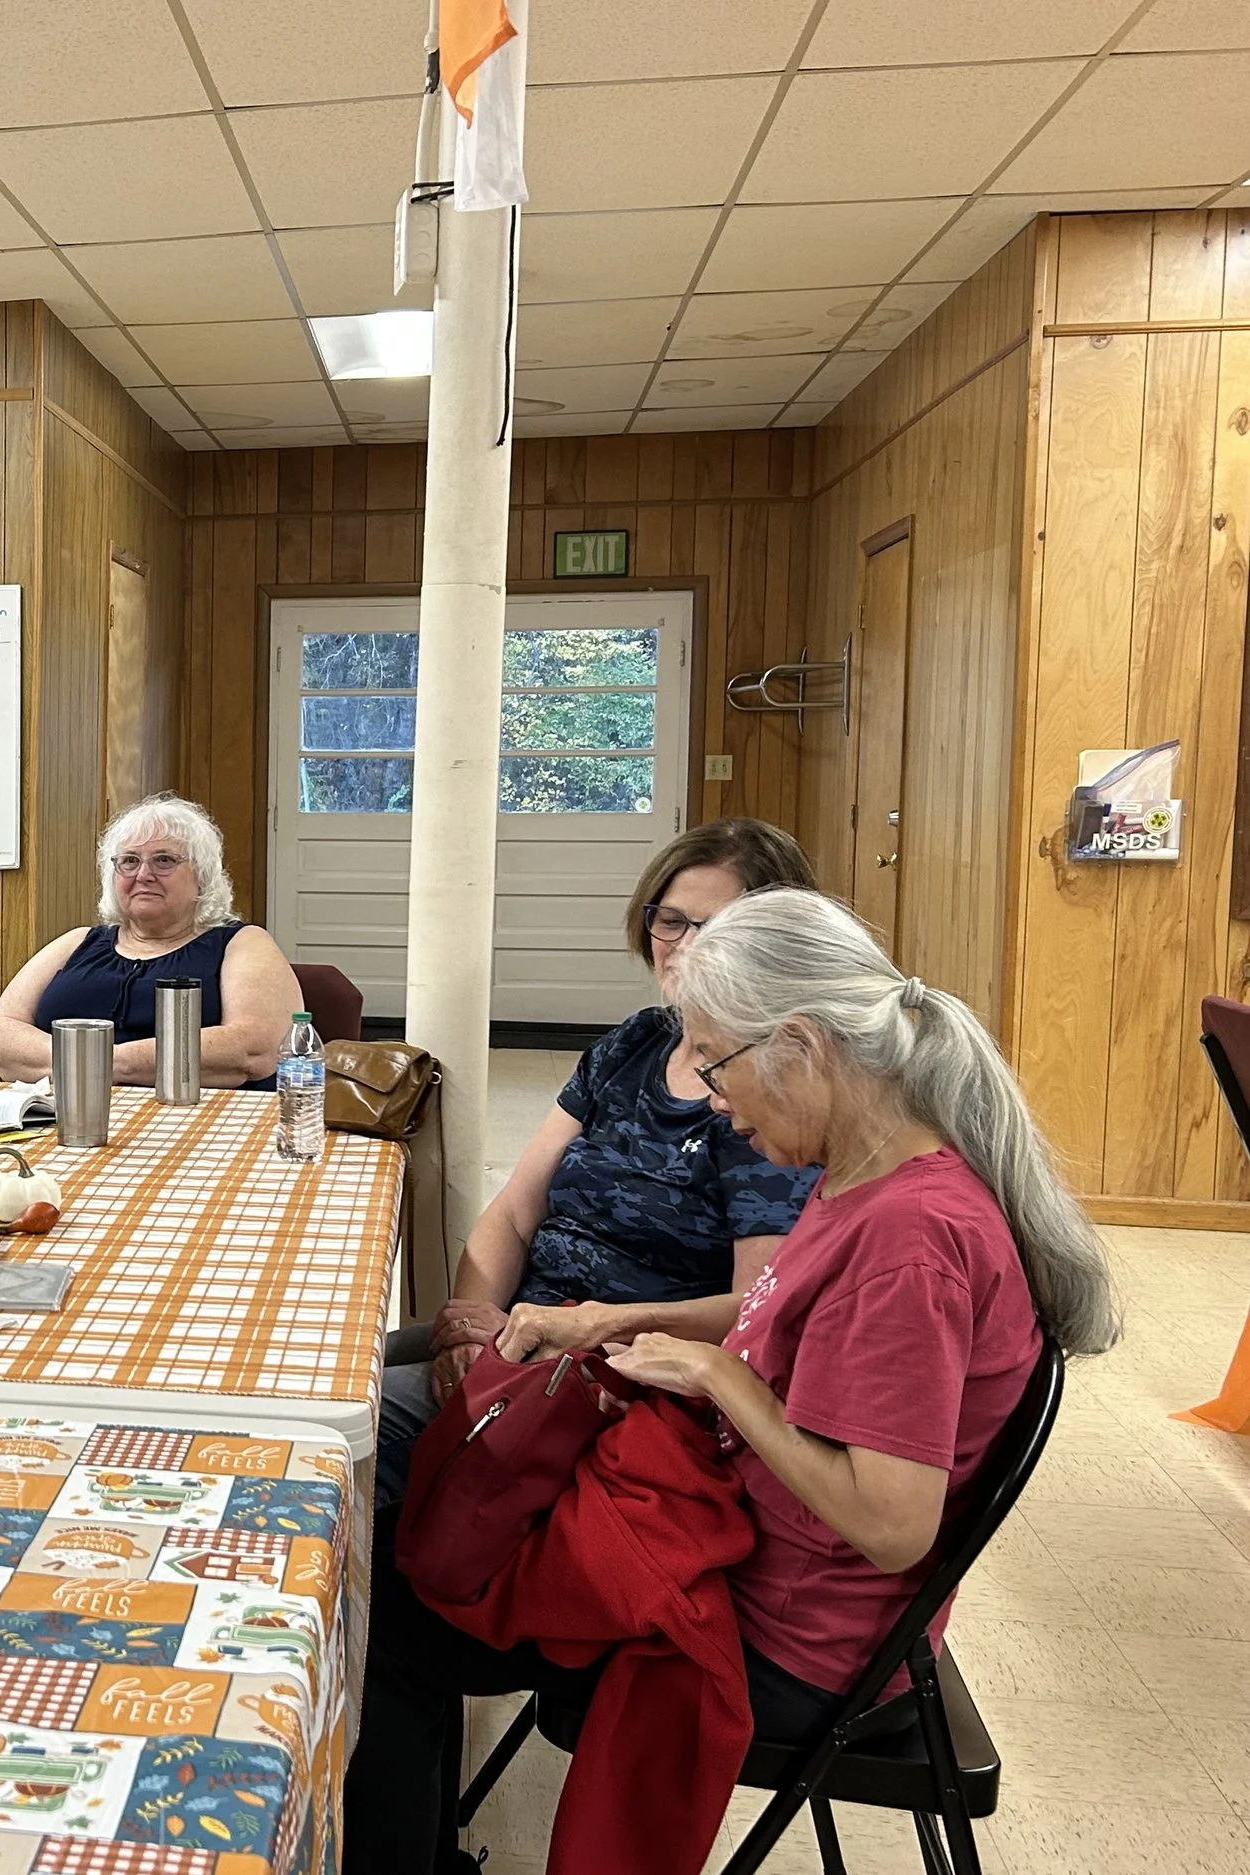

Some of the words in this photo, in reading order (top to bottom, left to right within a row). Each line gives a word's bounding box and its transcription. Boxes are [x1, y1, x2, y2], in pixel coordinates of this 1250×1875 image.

[566, 535, 619, 573] EXIT
[1092, 833, 1161, 850] MSDS
[198, 1442, 282, 1458] fall
[208, 1455, 267, 1469] FEELS
[52, 1578, 149, 1600] fall
[62, 1592, 131, 1617] FEELS
[100, 1677, 215, 1706] fall
[112, 1699, 194, 1725] FEELS
